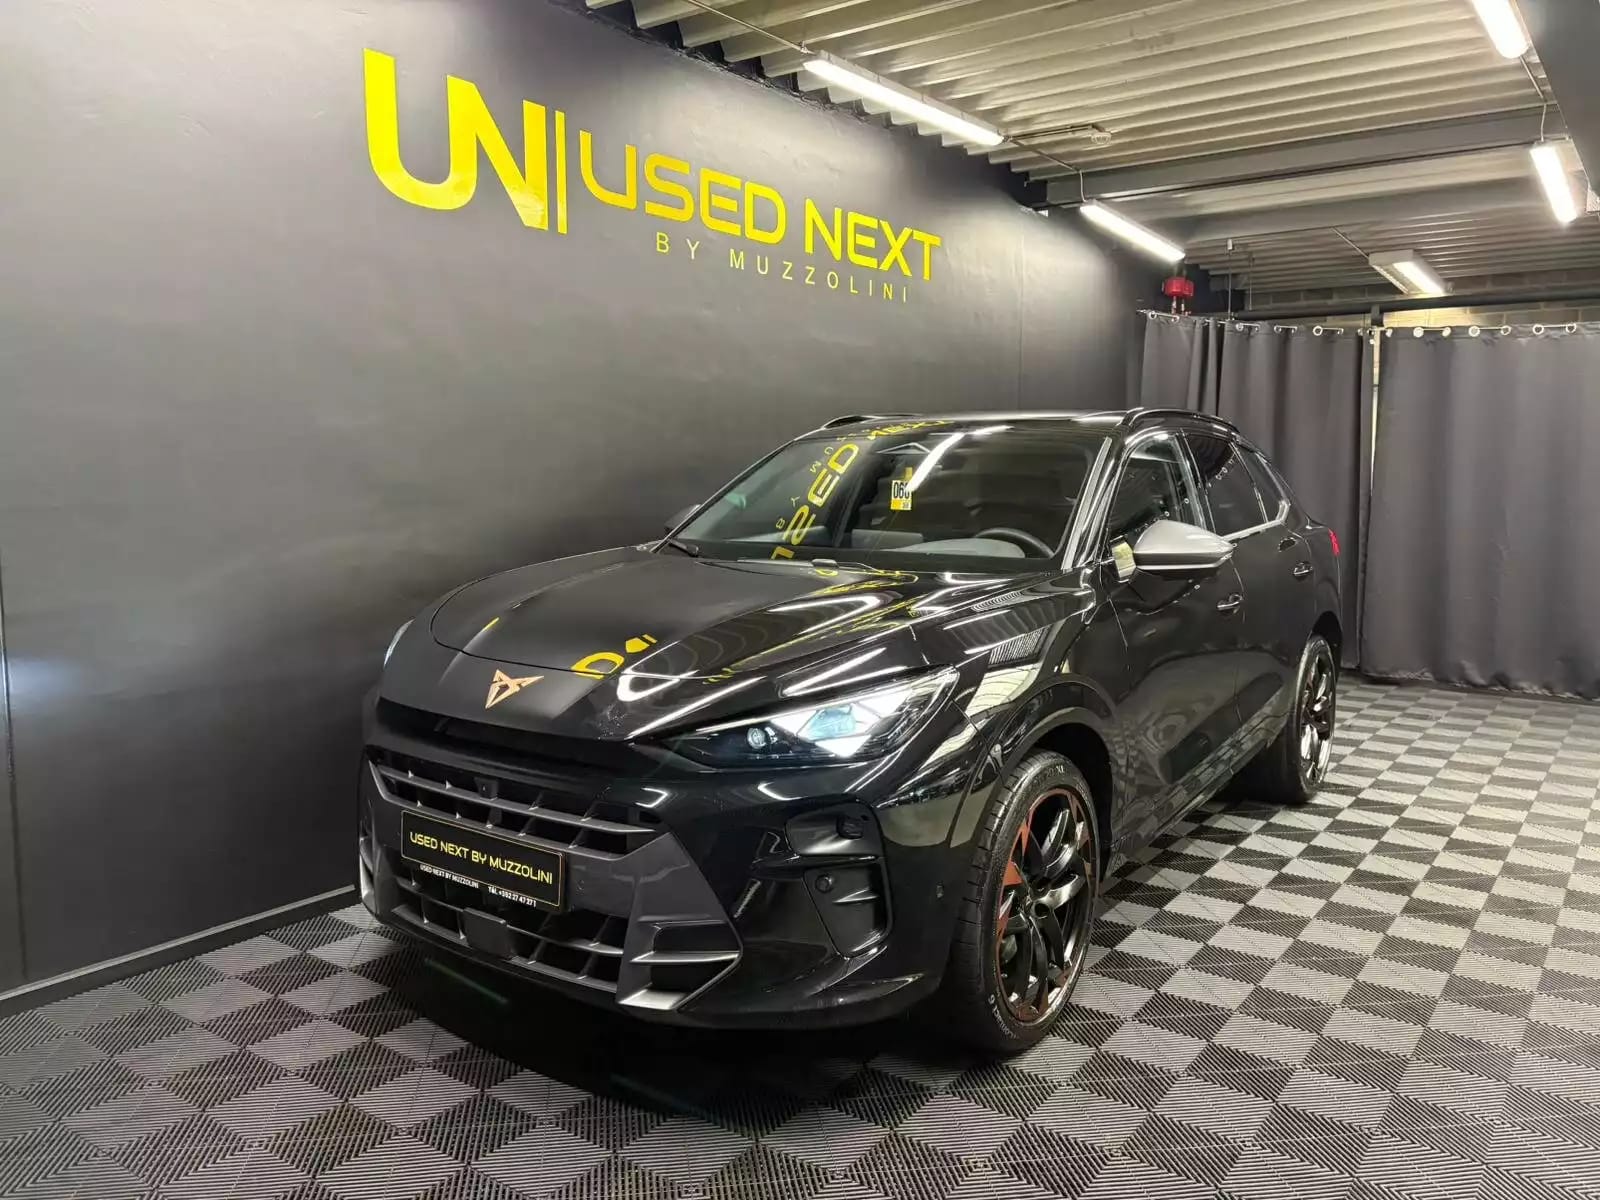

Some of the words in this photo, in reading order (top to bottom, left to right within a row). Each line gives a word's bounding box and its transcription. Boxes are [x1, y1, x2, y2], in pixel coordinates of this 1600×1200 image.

[579, 130, 787, 246] USED
[803, 197, 943, 282] NEXT
[655, 231, 700, 261] BY
[730, 250, 908, 303] MUZZOLINI
[409, 831, 438, 850] USED
[440, 841, 469, 859] NEXT
[471, 850, 487, 865] BY
[489, 855, 553, 885] MUZZOLINI
[420, 864, 432, 874] USED
[433, 868, 445, 878] NEXT
[445, 872, 451, 880] BY
[452, 873, 479, 889] MUZZOLINI
